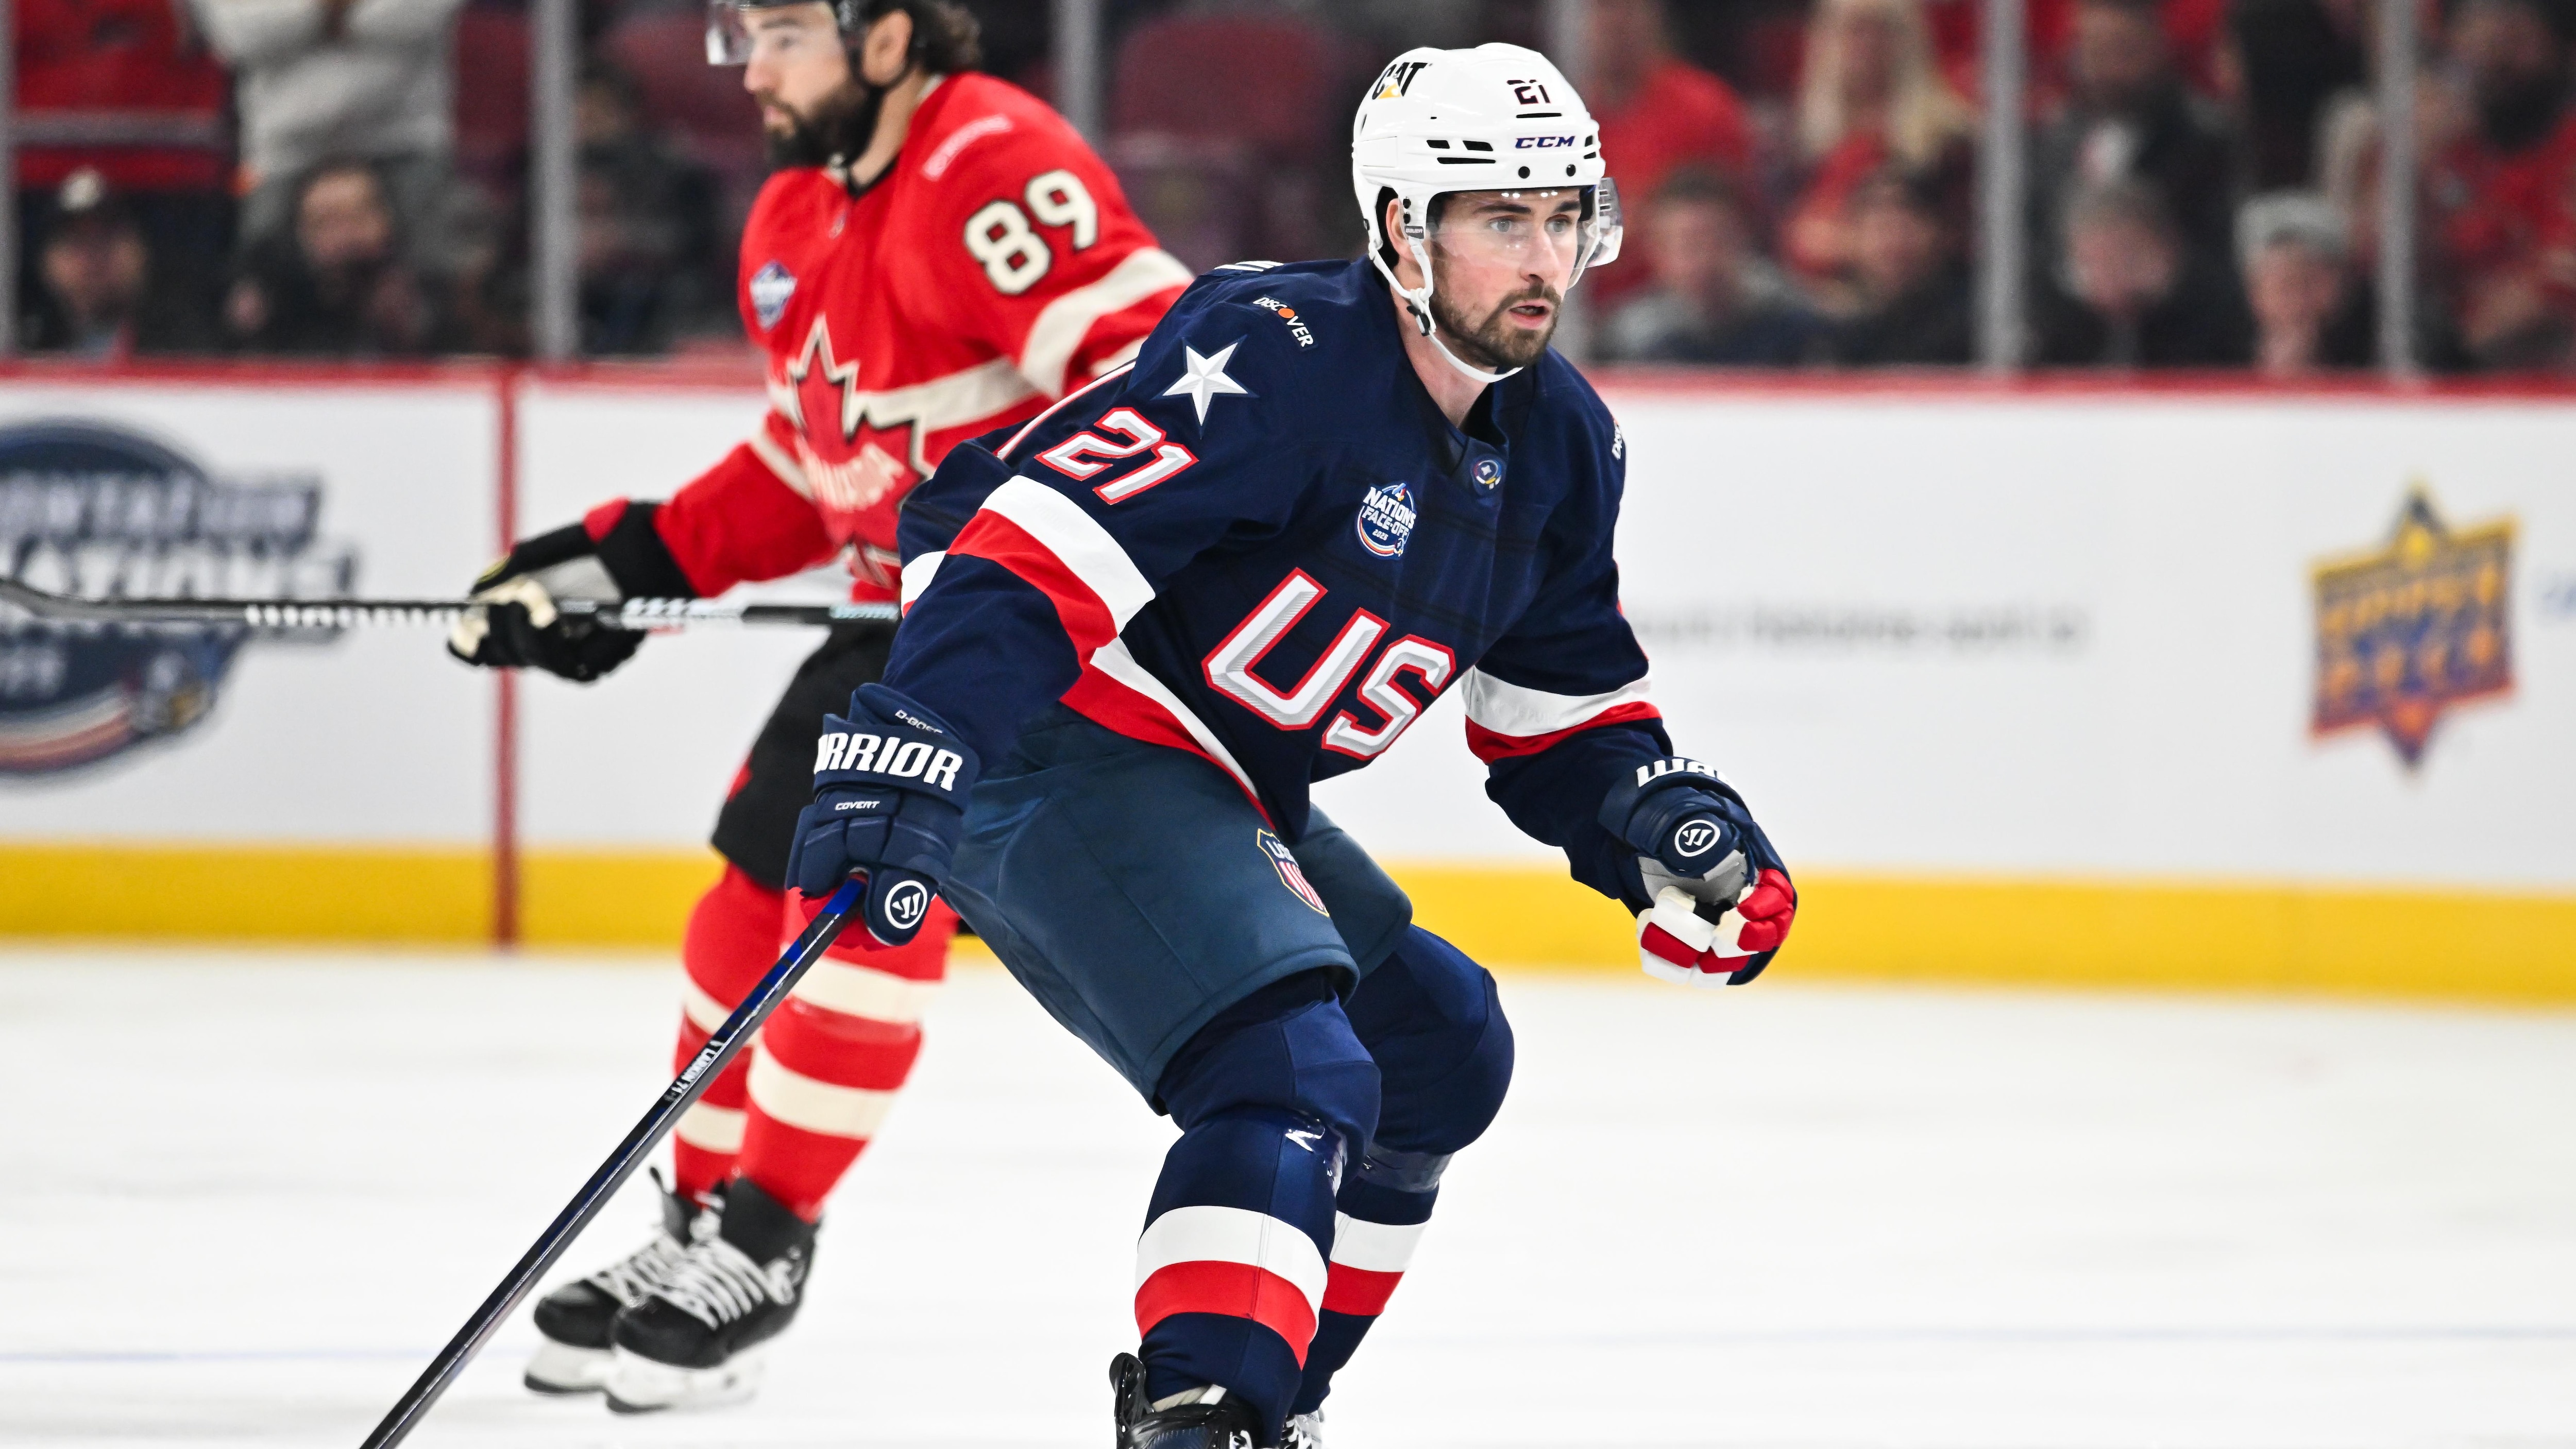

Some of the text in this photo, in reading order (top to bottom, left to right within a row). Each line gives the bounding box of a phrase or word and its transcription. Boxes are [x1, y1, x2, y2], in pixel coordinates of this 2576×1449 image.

[1371, 62, 1429, 100] CAT
[1506, 79, 1551, 105] 21
[1515, 135, 1575, 149] CCM
[964, 168, 1099, 296] 89
[1252, 297, 1314, 348] DISCOVER
[1034, 406, 1199, 505] 21
[1361, 505, 1410, 538] FACE-OFF
[1363, 486, 1417, 530] NATIONS
[1201, 567, 1456, 760] US
[834, 800, 880, 811] COVERT
